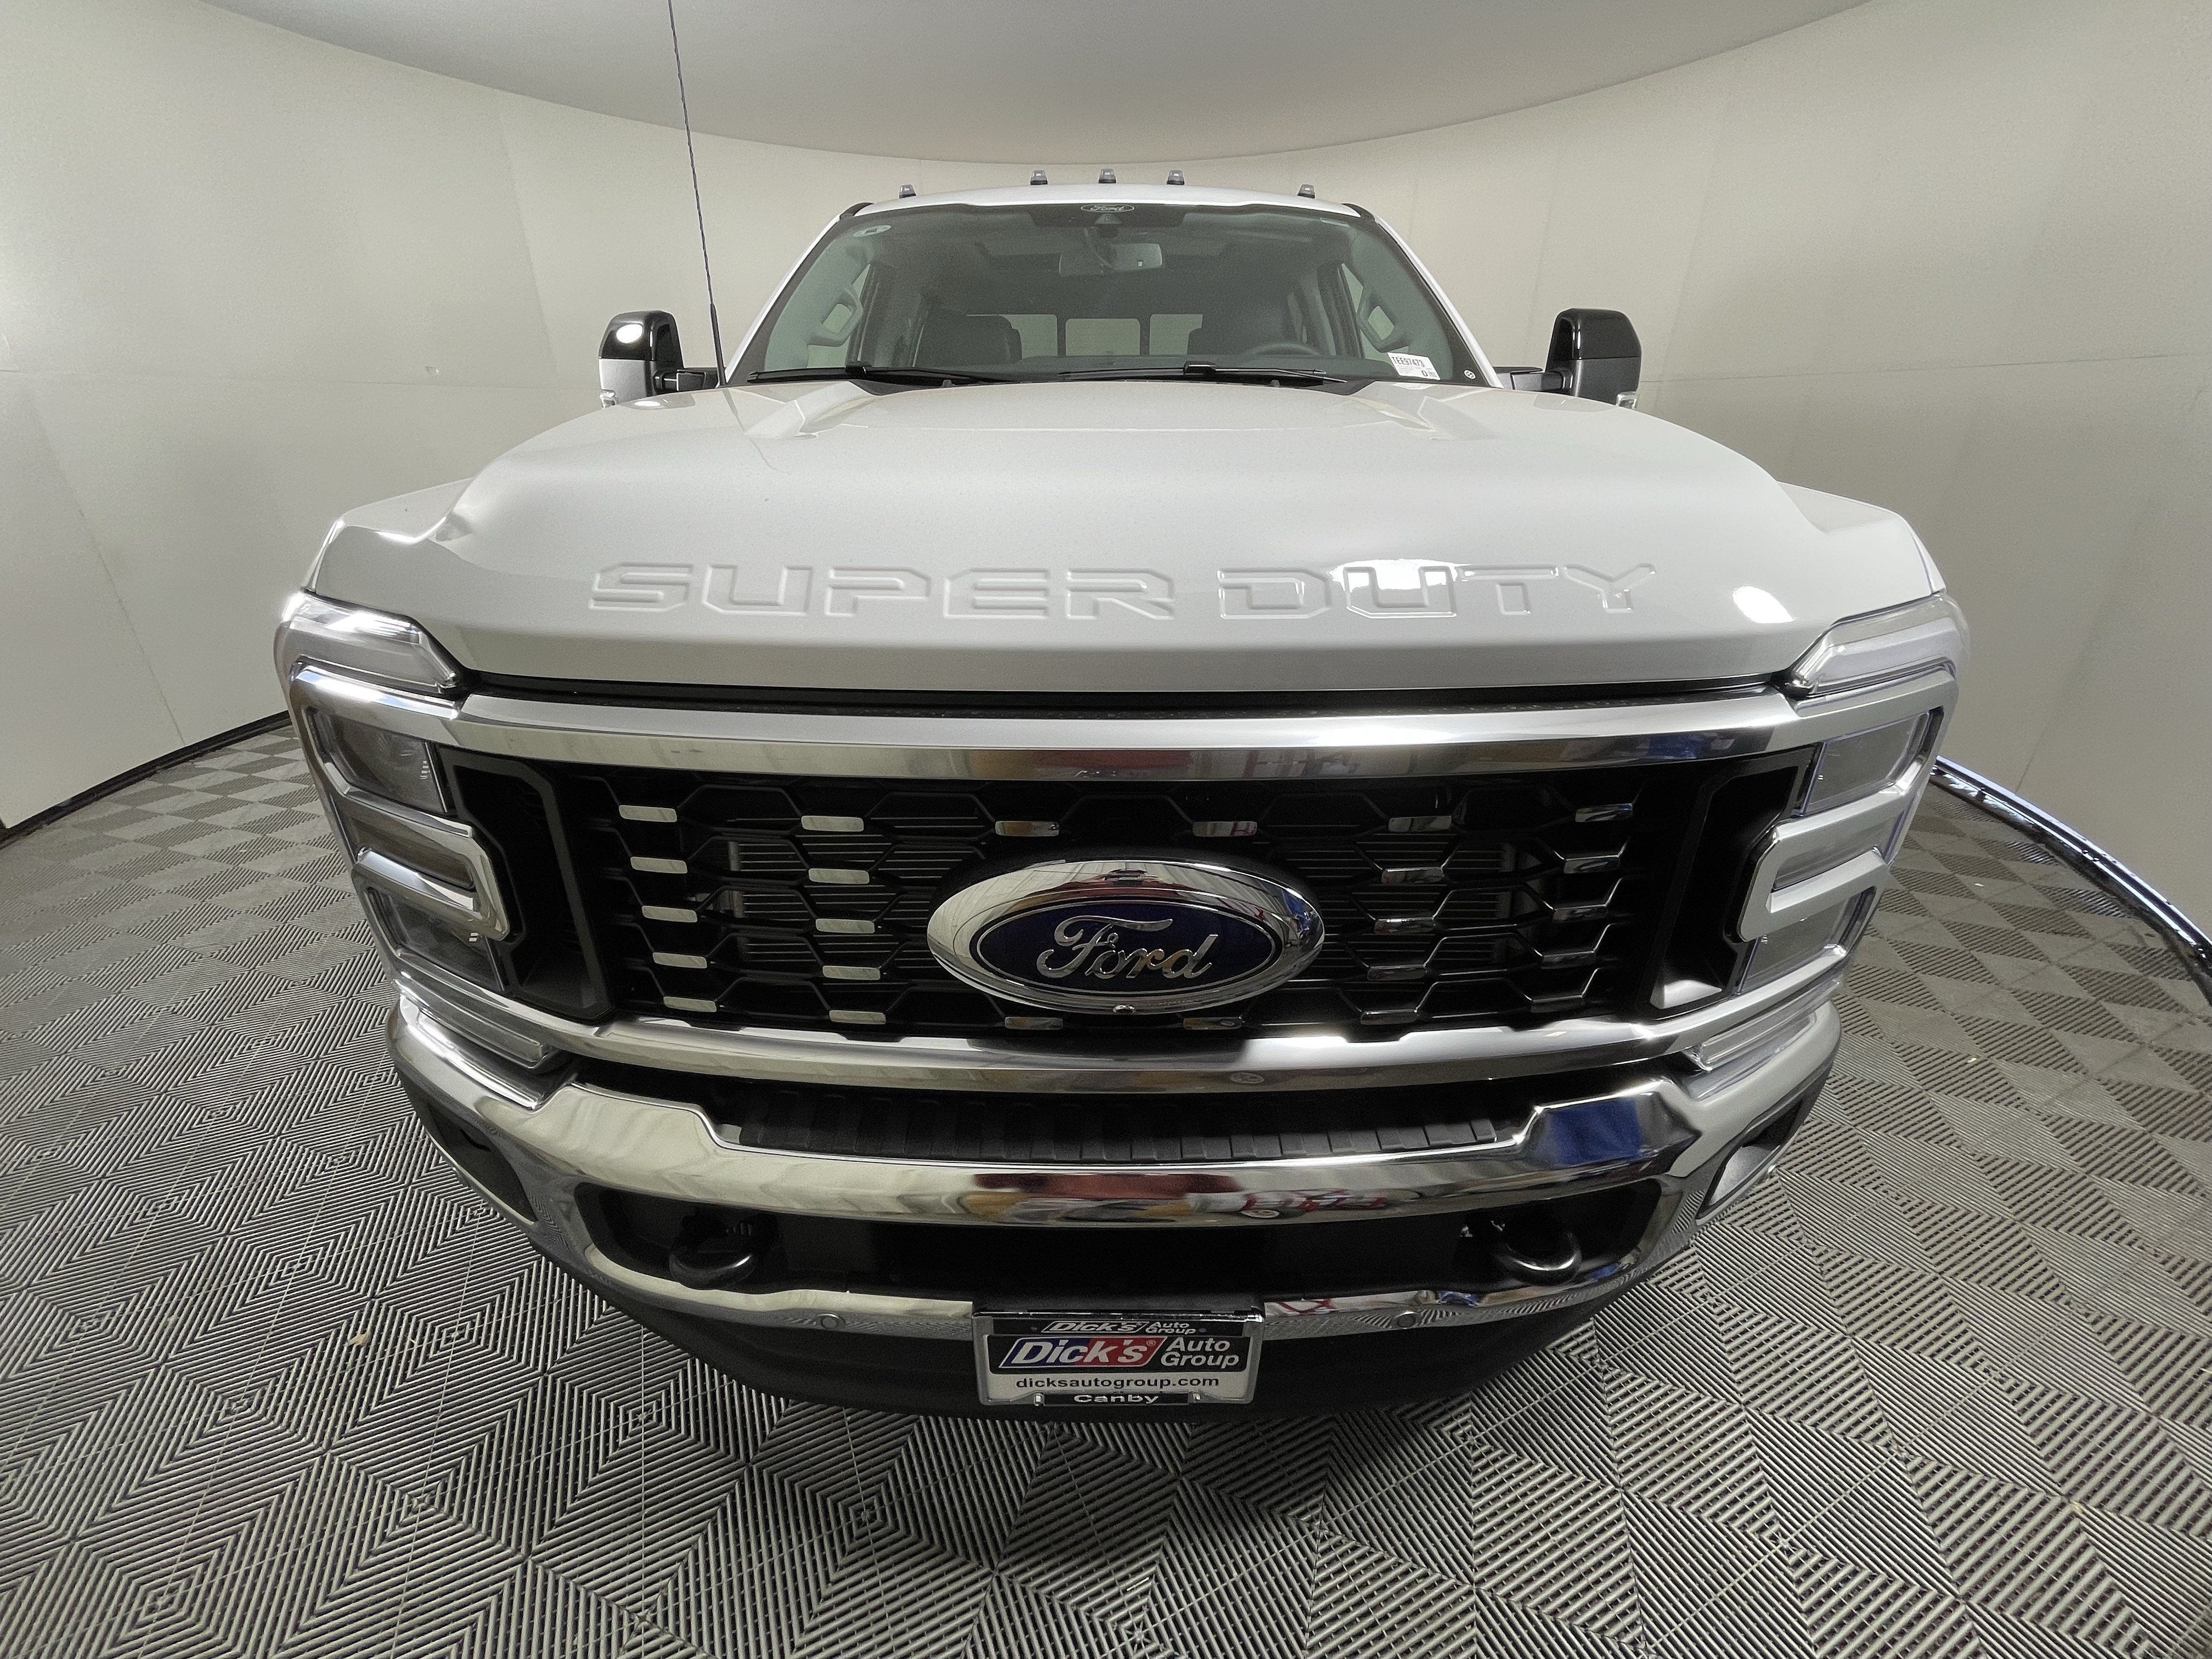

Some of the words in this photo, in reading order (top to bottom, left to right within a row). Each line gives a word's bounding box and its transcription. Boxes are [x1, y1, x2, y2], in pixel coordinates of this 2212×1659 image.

[588, 562, 1175, 620] SUPER
[1217, 563, 1656, 619] DUTY
[1036, 915, 1218, 979] Ford
[1049, 1321, 1138, 1332] Dick's
[1011, 1340, 1148, 1364] Dick's
[1165, 1336, 1231, 1352] Auto
[1160, 1351, 1239, 1369] Group
[1015, 1377, 1220, 1389] dicksautogroup.com
[1073, 1394, 1160, 1404] Canby
